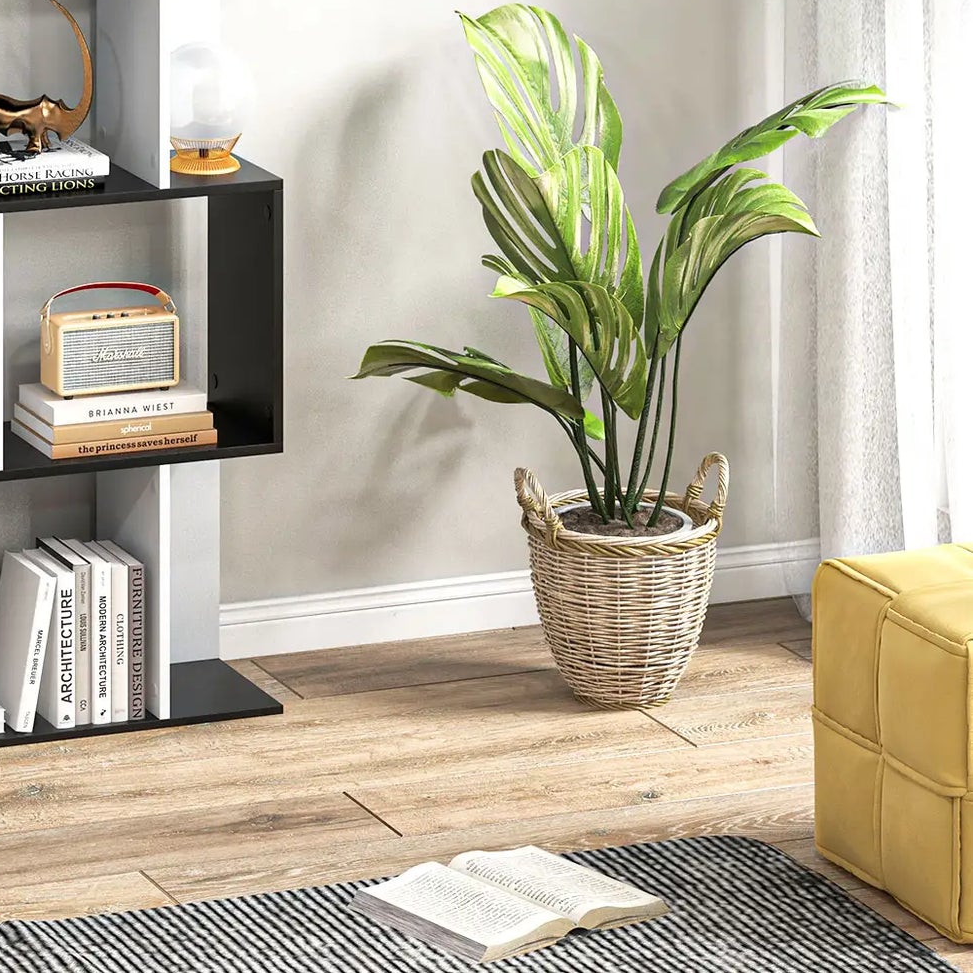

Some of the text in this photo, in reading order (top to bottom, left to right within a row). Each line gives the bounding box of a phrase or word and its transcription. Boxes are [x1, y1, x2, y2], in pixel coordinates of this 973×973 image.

[45, 168, 94, 179] RACING
[51, 178, 95, 191] LIONS
[91, 346, 146, 363] Marshall
[88, 402, 175, 418] BRIANNA WIEST
[120, 422, 152, 435] spherical
[78, 433, 198, 454] the princess saves herself
[98, 595, 107, 632] MODERN
[60, 588, 73, 703] ARCHITECTURE
[79, 613, 87, 652] LOUIS SULLIVAN
[116, 613, 124, 665] CLOTHING
[132, 567, 142, 719] FURNITURE DESIGN
[29, 629, 44, 685] MARCEL BREUER
[98, 633, 107, 699] ARCHITECTURE
